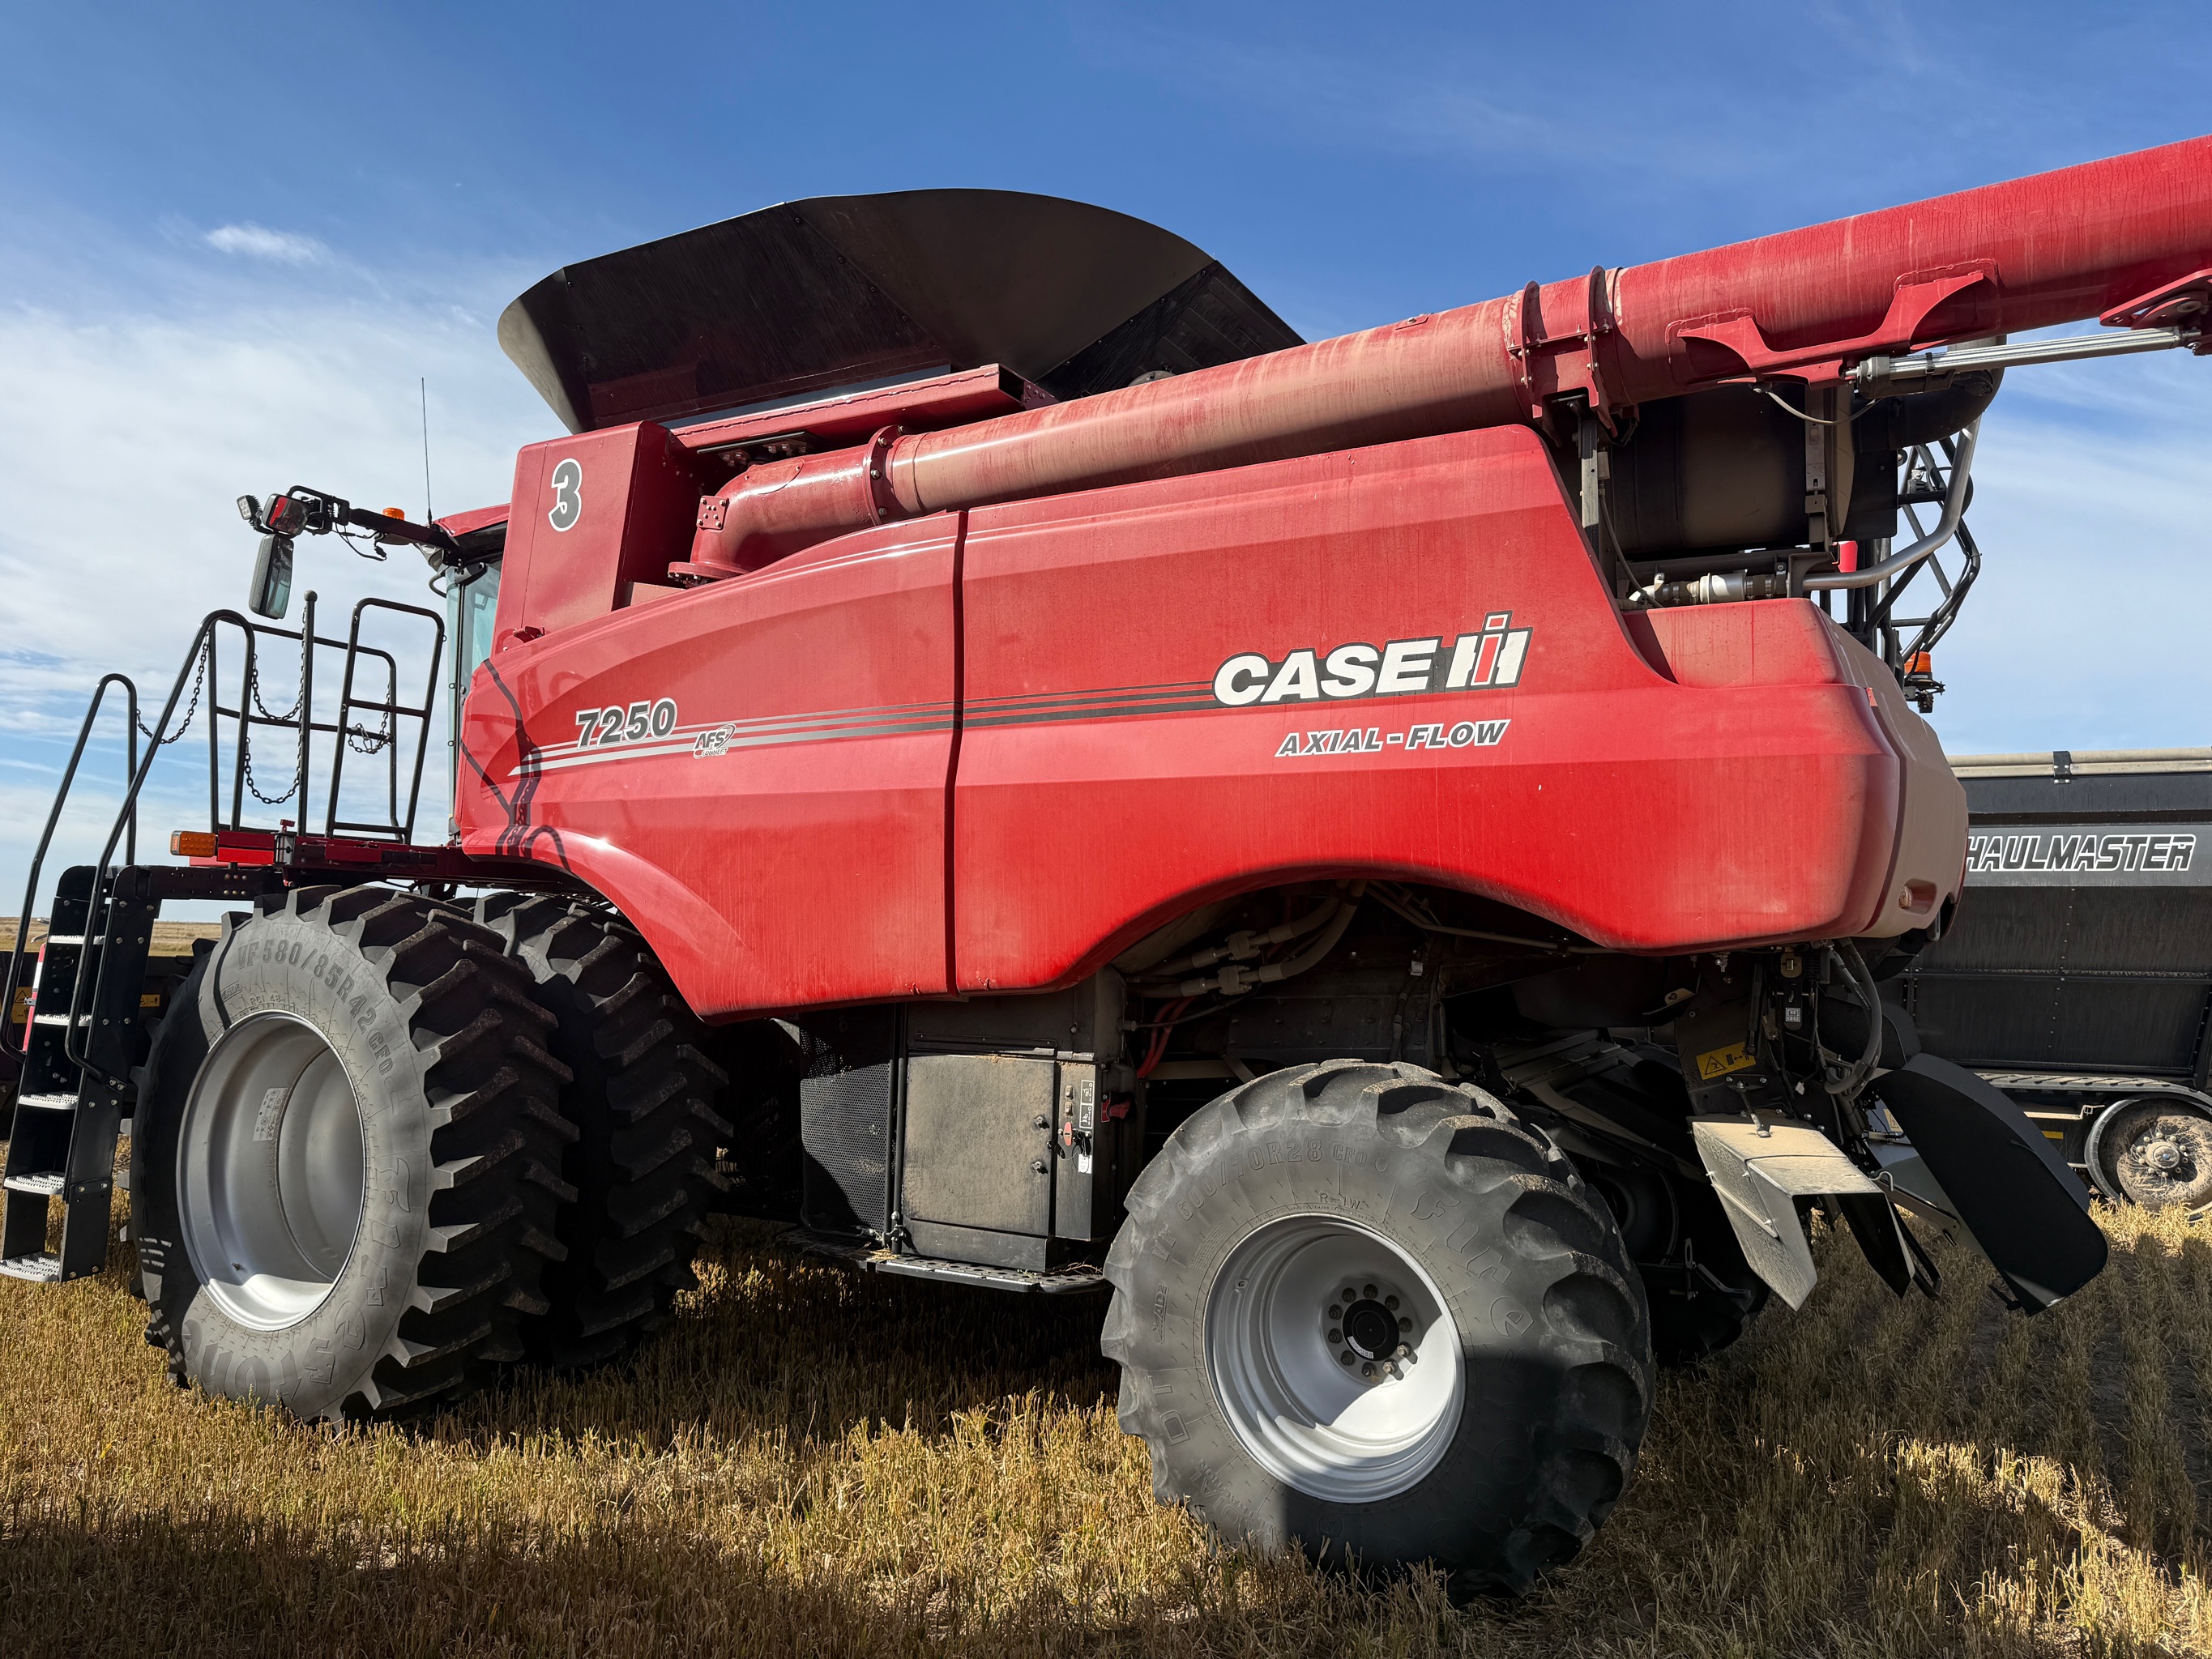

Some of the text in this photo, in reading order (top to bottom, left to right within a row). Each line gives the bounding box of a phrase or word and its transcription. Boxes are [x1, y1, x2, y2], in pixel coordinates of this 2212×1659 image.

[548, 458, 583, 532] 3
[1213, 638, 1441, 706] CASE
[576, 697, 677, 750] 7250
[694, 730, 727, 750] AFS
[1275, 719, 1511, 757] AXIAL-FLOW
[1966, 834, 2197, 872] HAULMASTER
[238, 940, 259, 970] VF
